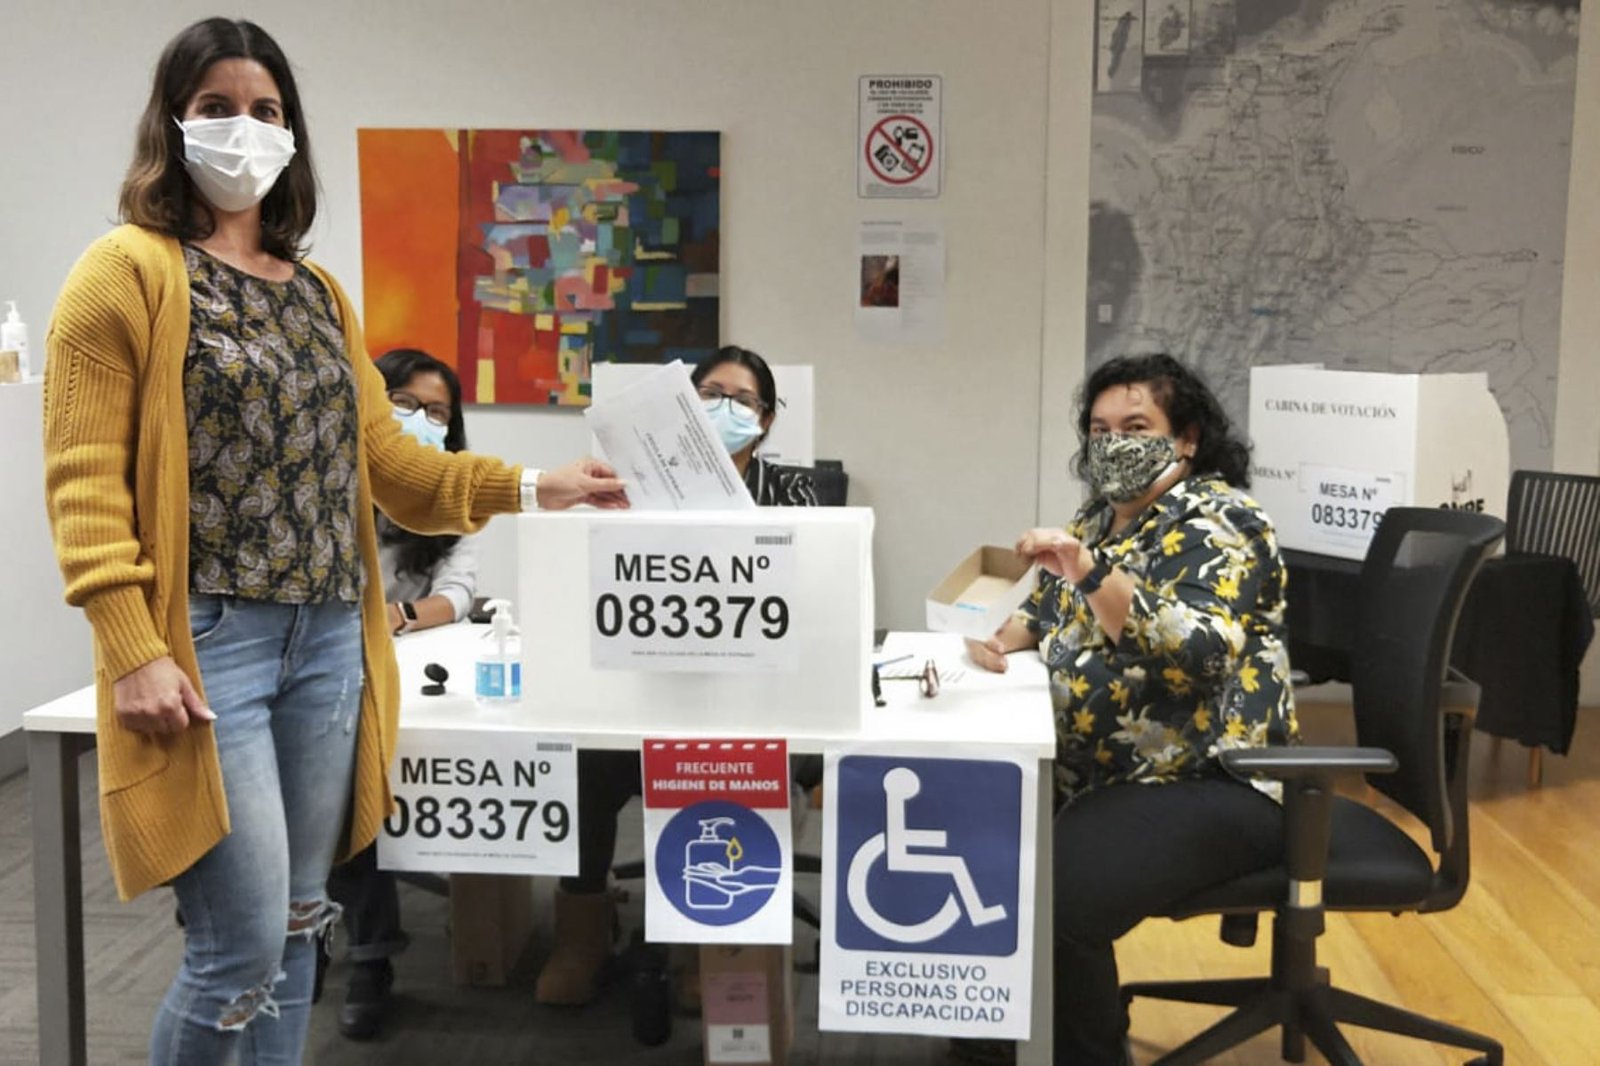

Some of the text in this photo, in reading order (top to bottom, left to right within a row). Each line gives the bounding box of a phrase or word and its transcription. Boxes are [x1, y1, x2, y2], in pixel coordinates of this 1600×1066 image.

[869, 79, 933, 89] PROHIBIDO
[1265, 400, 1397, 419] CABINA DE VOTACIÓN
[1320, 482, 1358, 499] MESA
[1312, 503, 1385, 531] 083379
[615, 553, 720, 583] MESA
[595, 593, 789, 640] 083379
[401, 757, 503, 787] MESA
[676, 762, 755, 774] FRECUENTE
[652, 780, 780, 791] HIGIENE DE MANOS
[865, 960, 987, 982] EXCLUSIVO
[840, 980, 1011, 1003] PERSONAS CON
[845, 1000, 1005, 1023] DISCAPACIDAD
